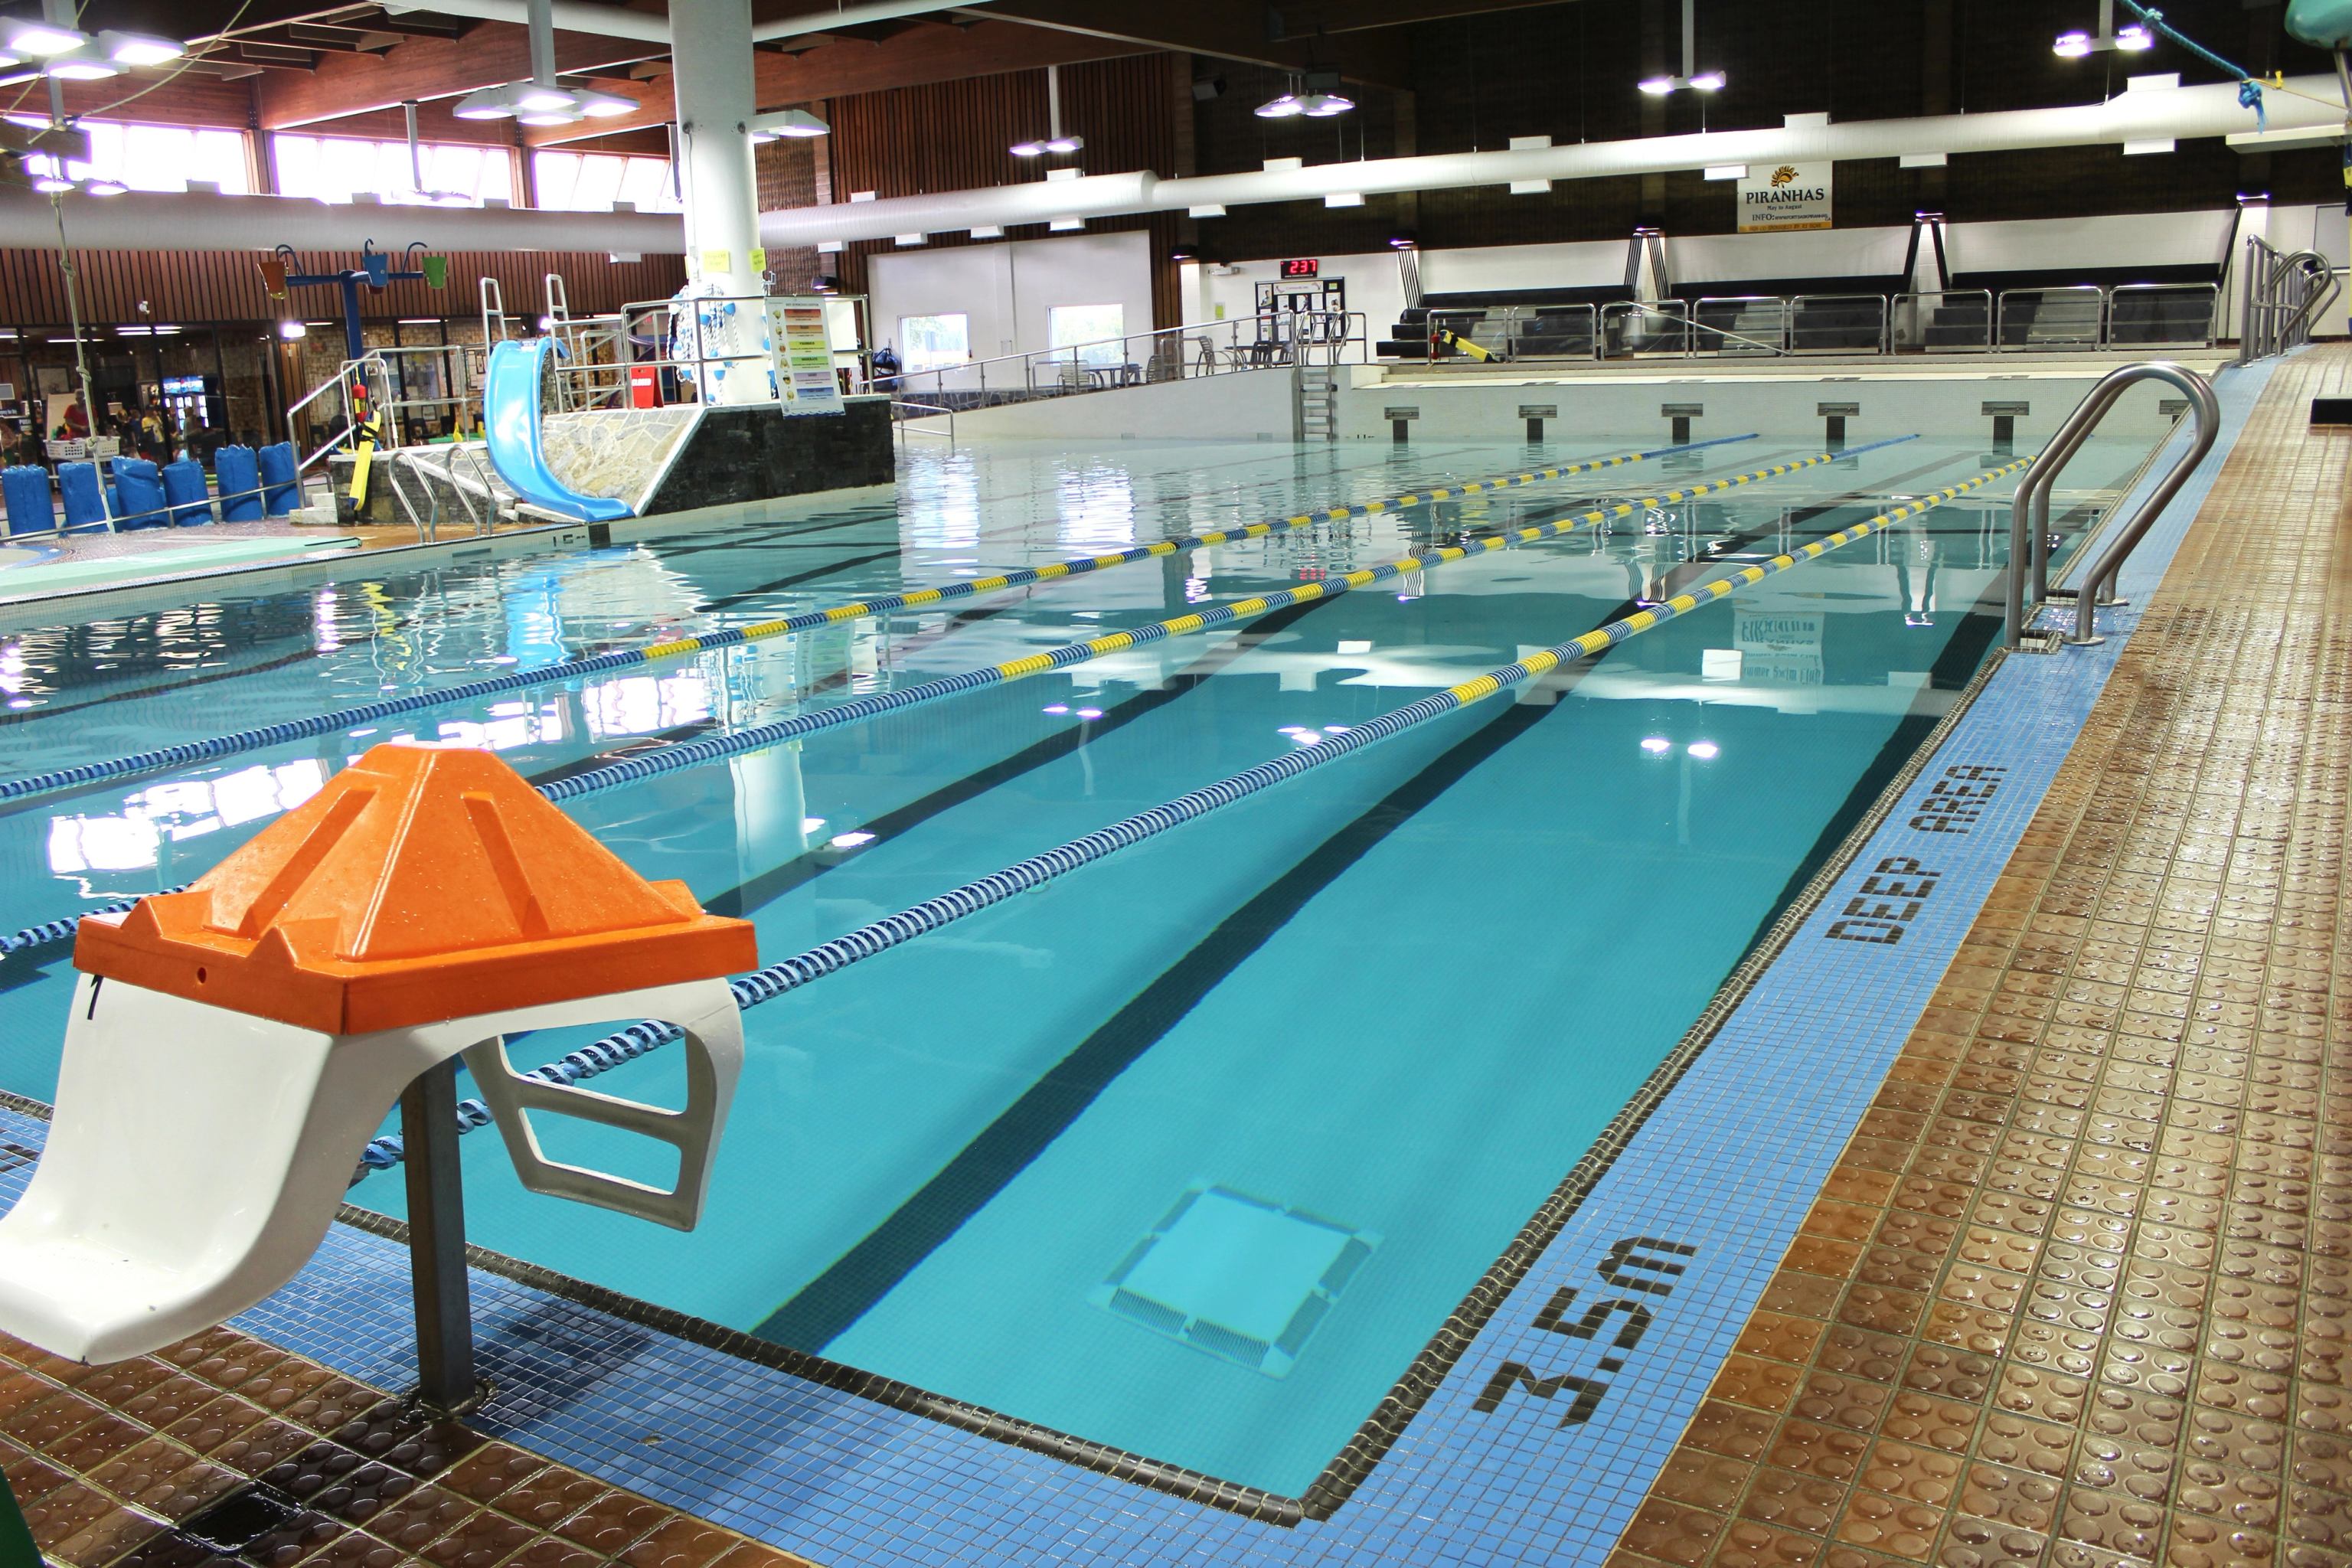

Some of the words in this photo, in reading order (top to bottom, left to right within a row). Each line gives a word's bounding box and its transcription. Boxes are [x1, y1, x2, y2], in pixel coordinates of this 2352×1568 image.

[1746, 188, 1824, 204] PIRANHAS
[1752, 213, 1775, 221] INFO:
[1825, 857, 1942, 945] DEEP
[1908, 765, 2010, 834] AREA
[87, 974, 104, 1021] 1
[1472, 1236, 1697, 1429] 3.5m
